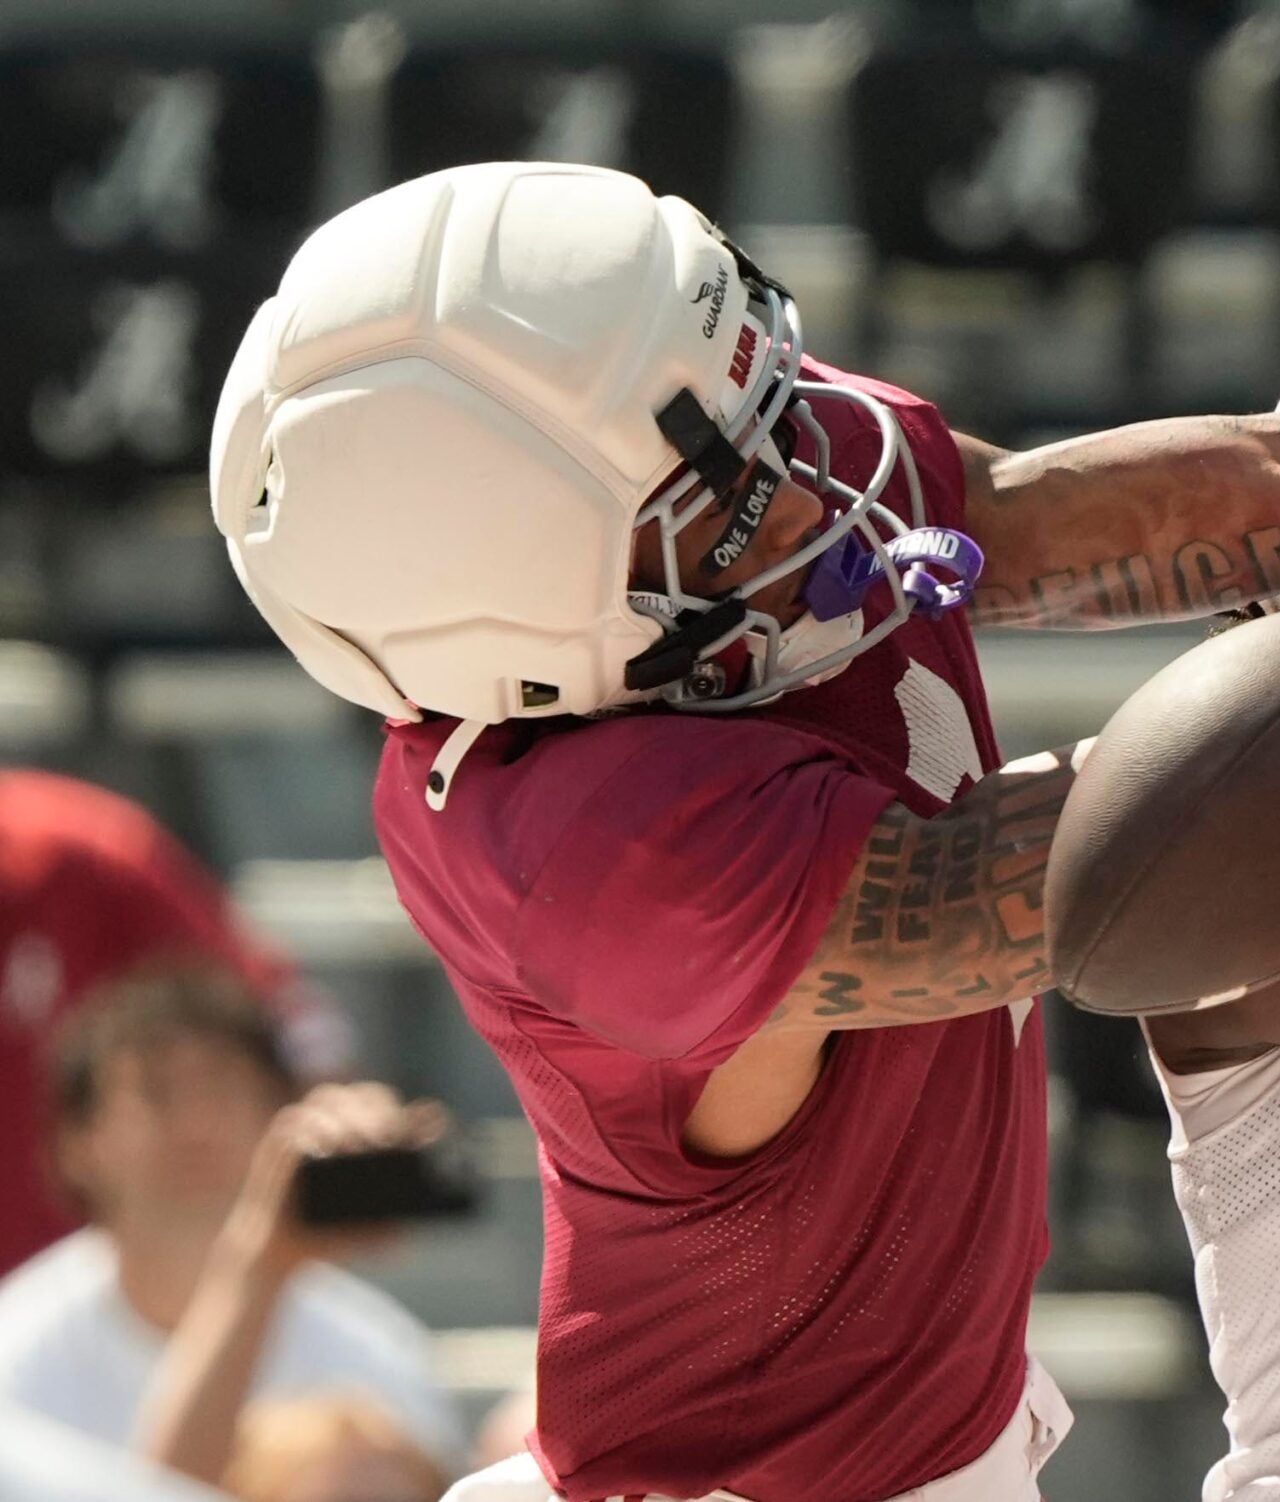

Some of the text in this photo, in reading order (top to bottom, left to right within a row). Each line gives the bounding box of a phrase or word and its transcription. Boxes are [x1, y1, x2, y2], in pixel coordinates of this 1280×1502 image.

[702, 267, 729, 339] GUARDIAN
[713, 477, 775, 568] ONE LOVE
